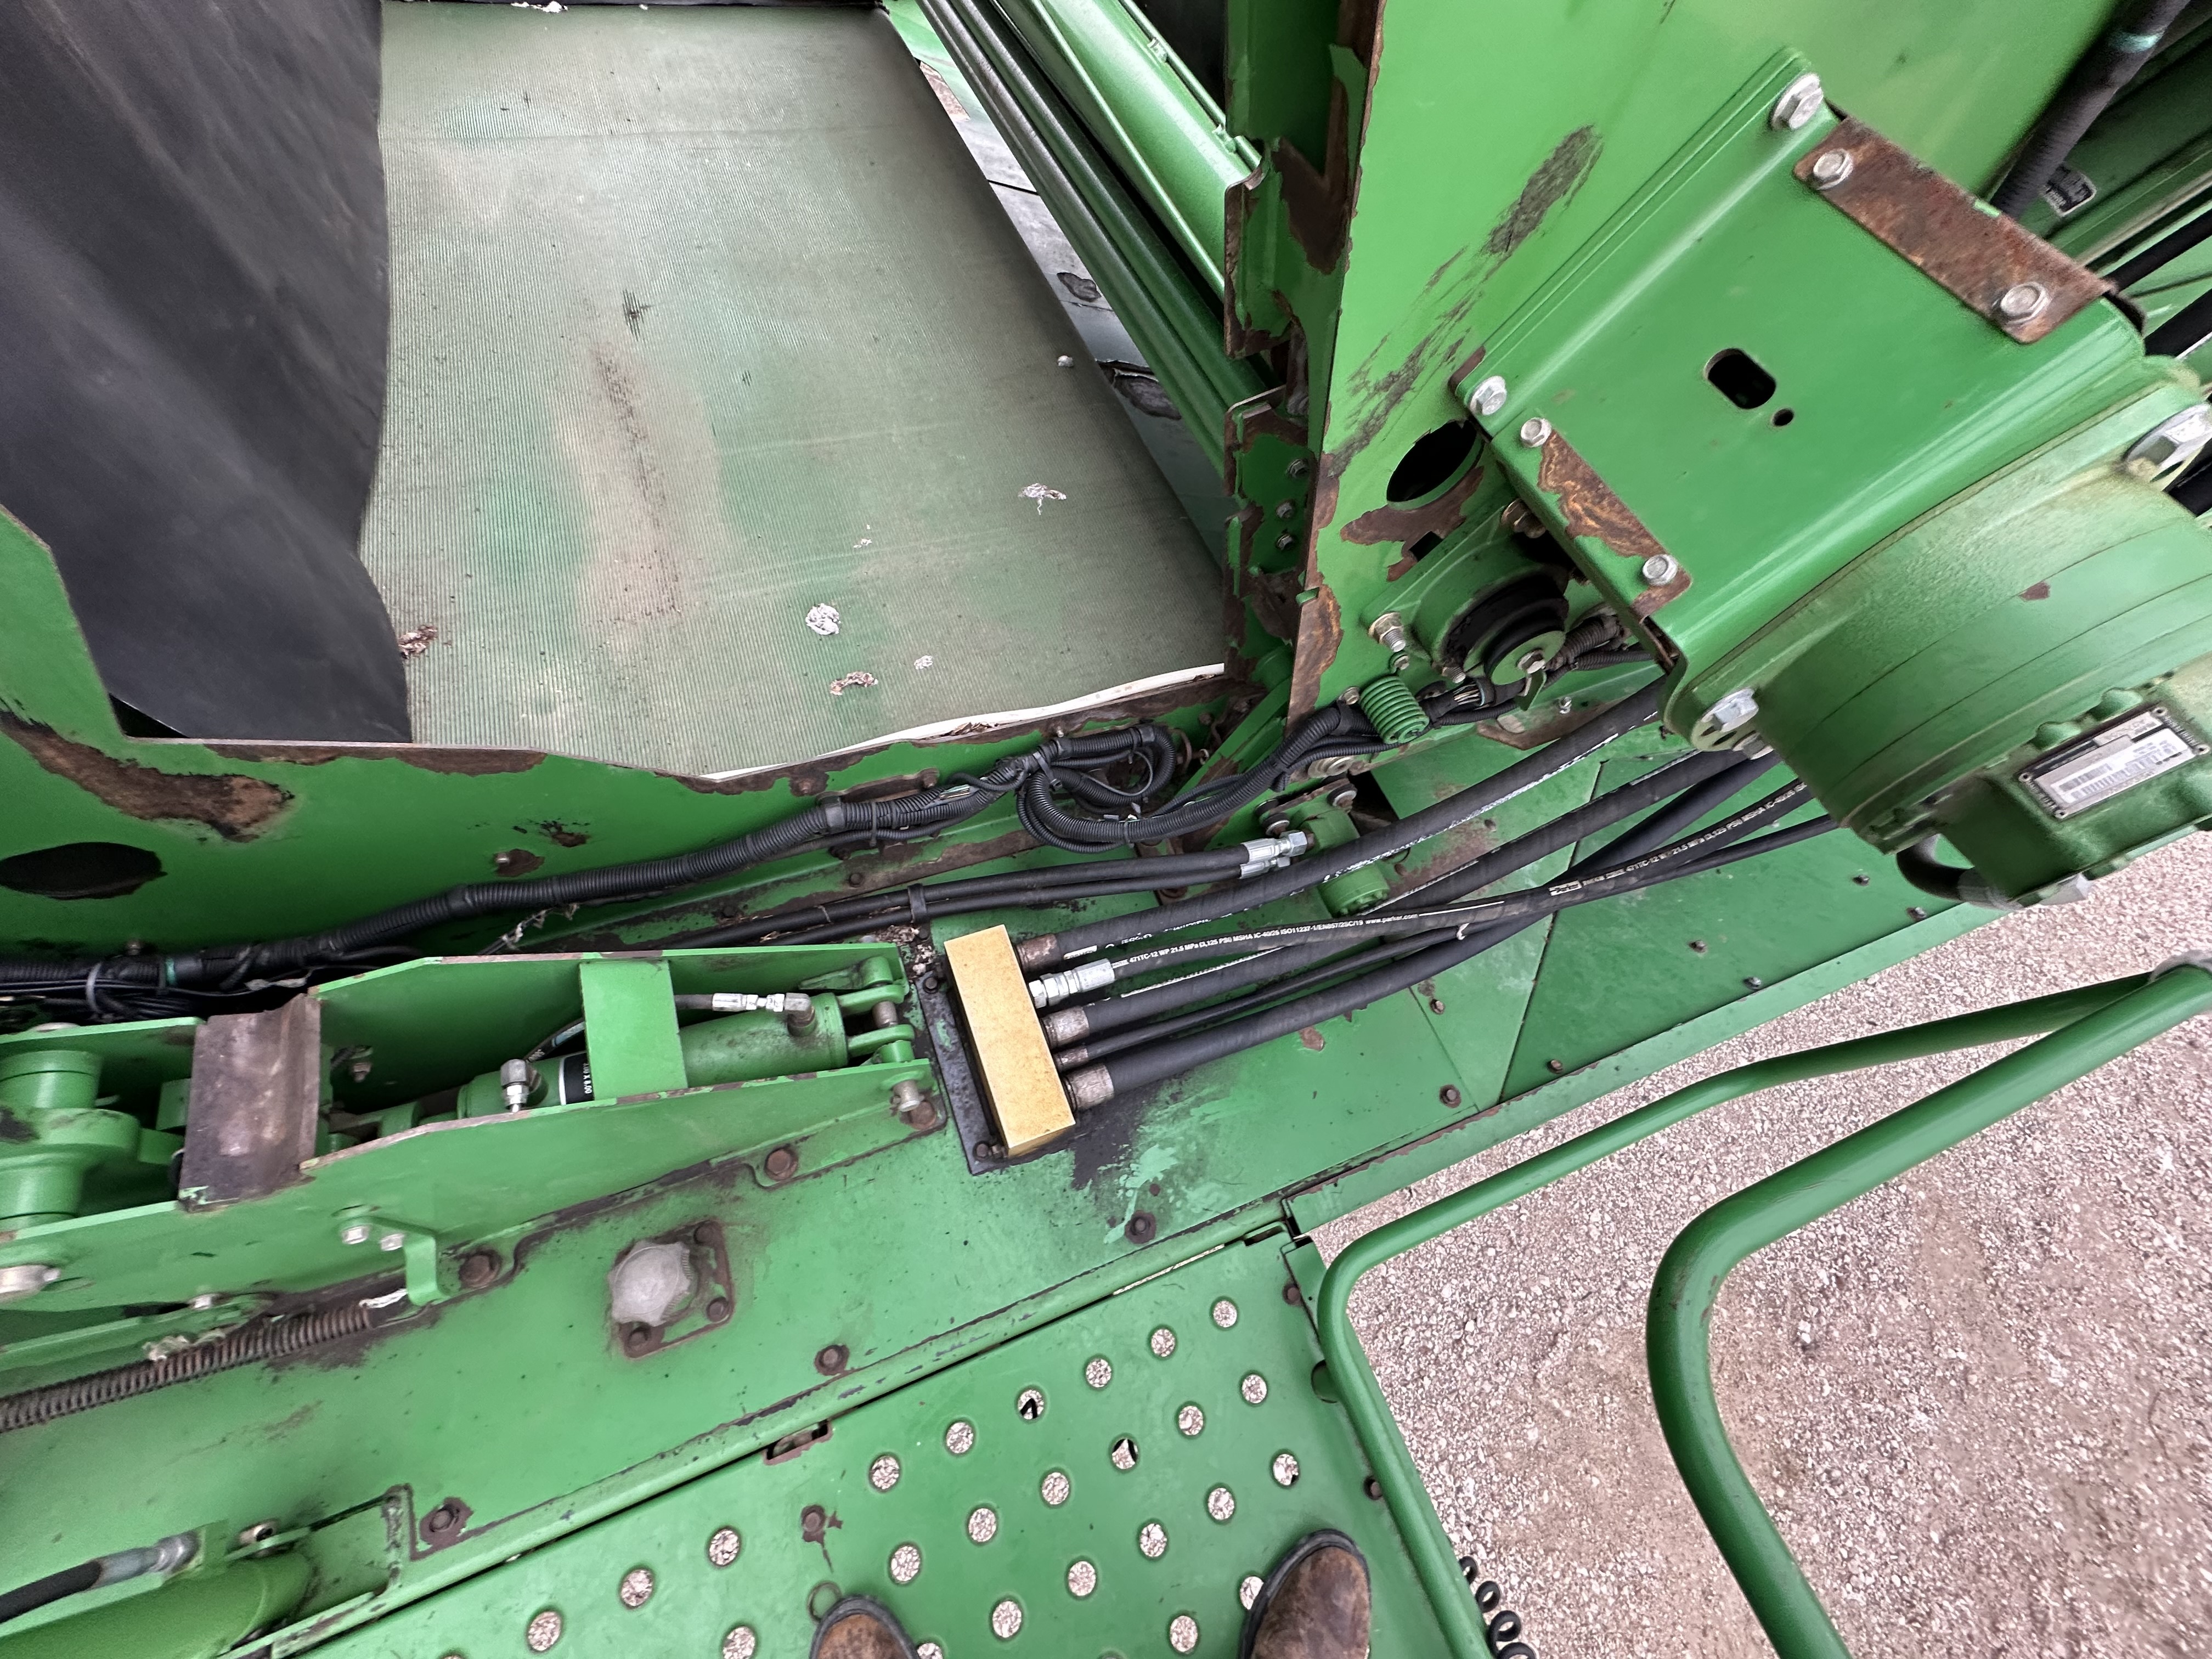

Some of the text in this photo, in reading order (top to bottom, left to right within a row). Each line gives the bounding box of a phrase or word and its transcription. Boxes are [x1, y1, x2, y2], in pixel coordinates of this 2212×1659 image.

[1130, 950, 1159, 963] 471TC-12
[1158, 948, 1170, 956] WP
[1184, 943, 1198, 951] MPa
[1233, 934, 1252, 943] MSHA
[1365, 913, 1419, 924] www.parker.com
